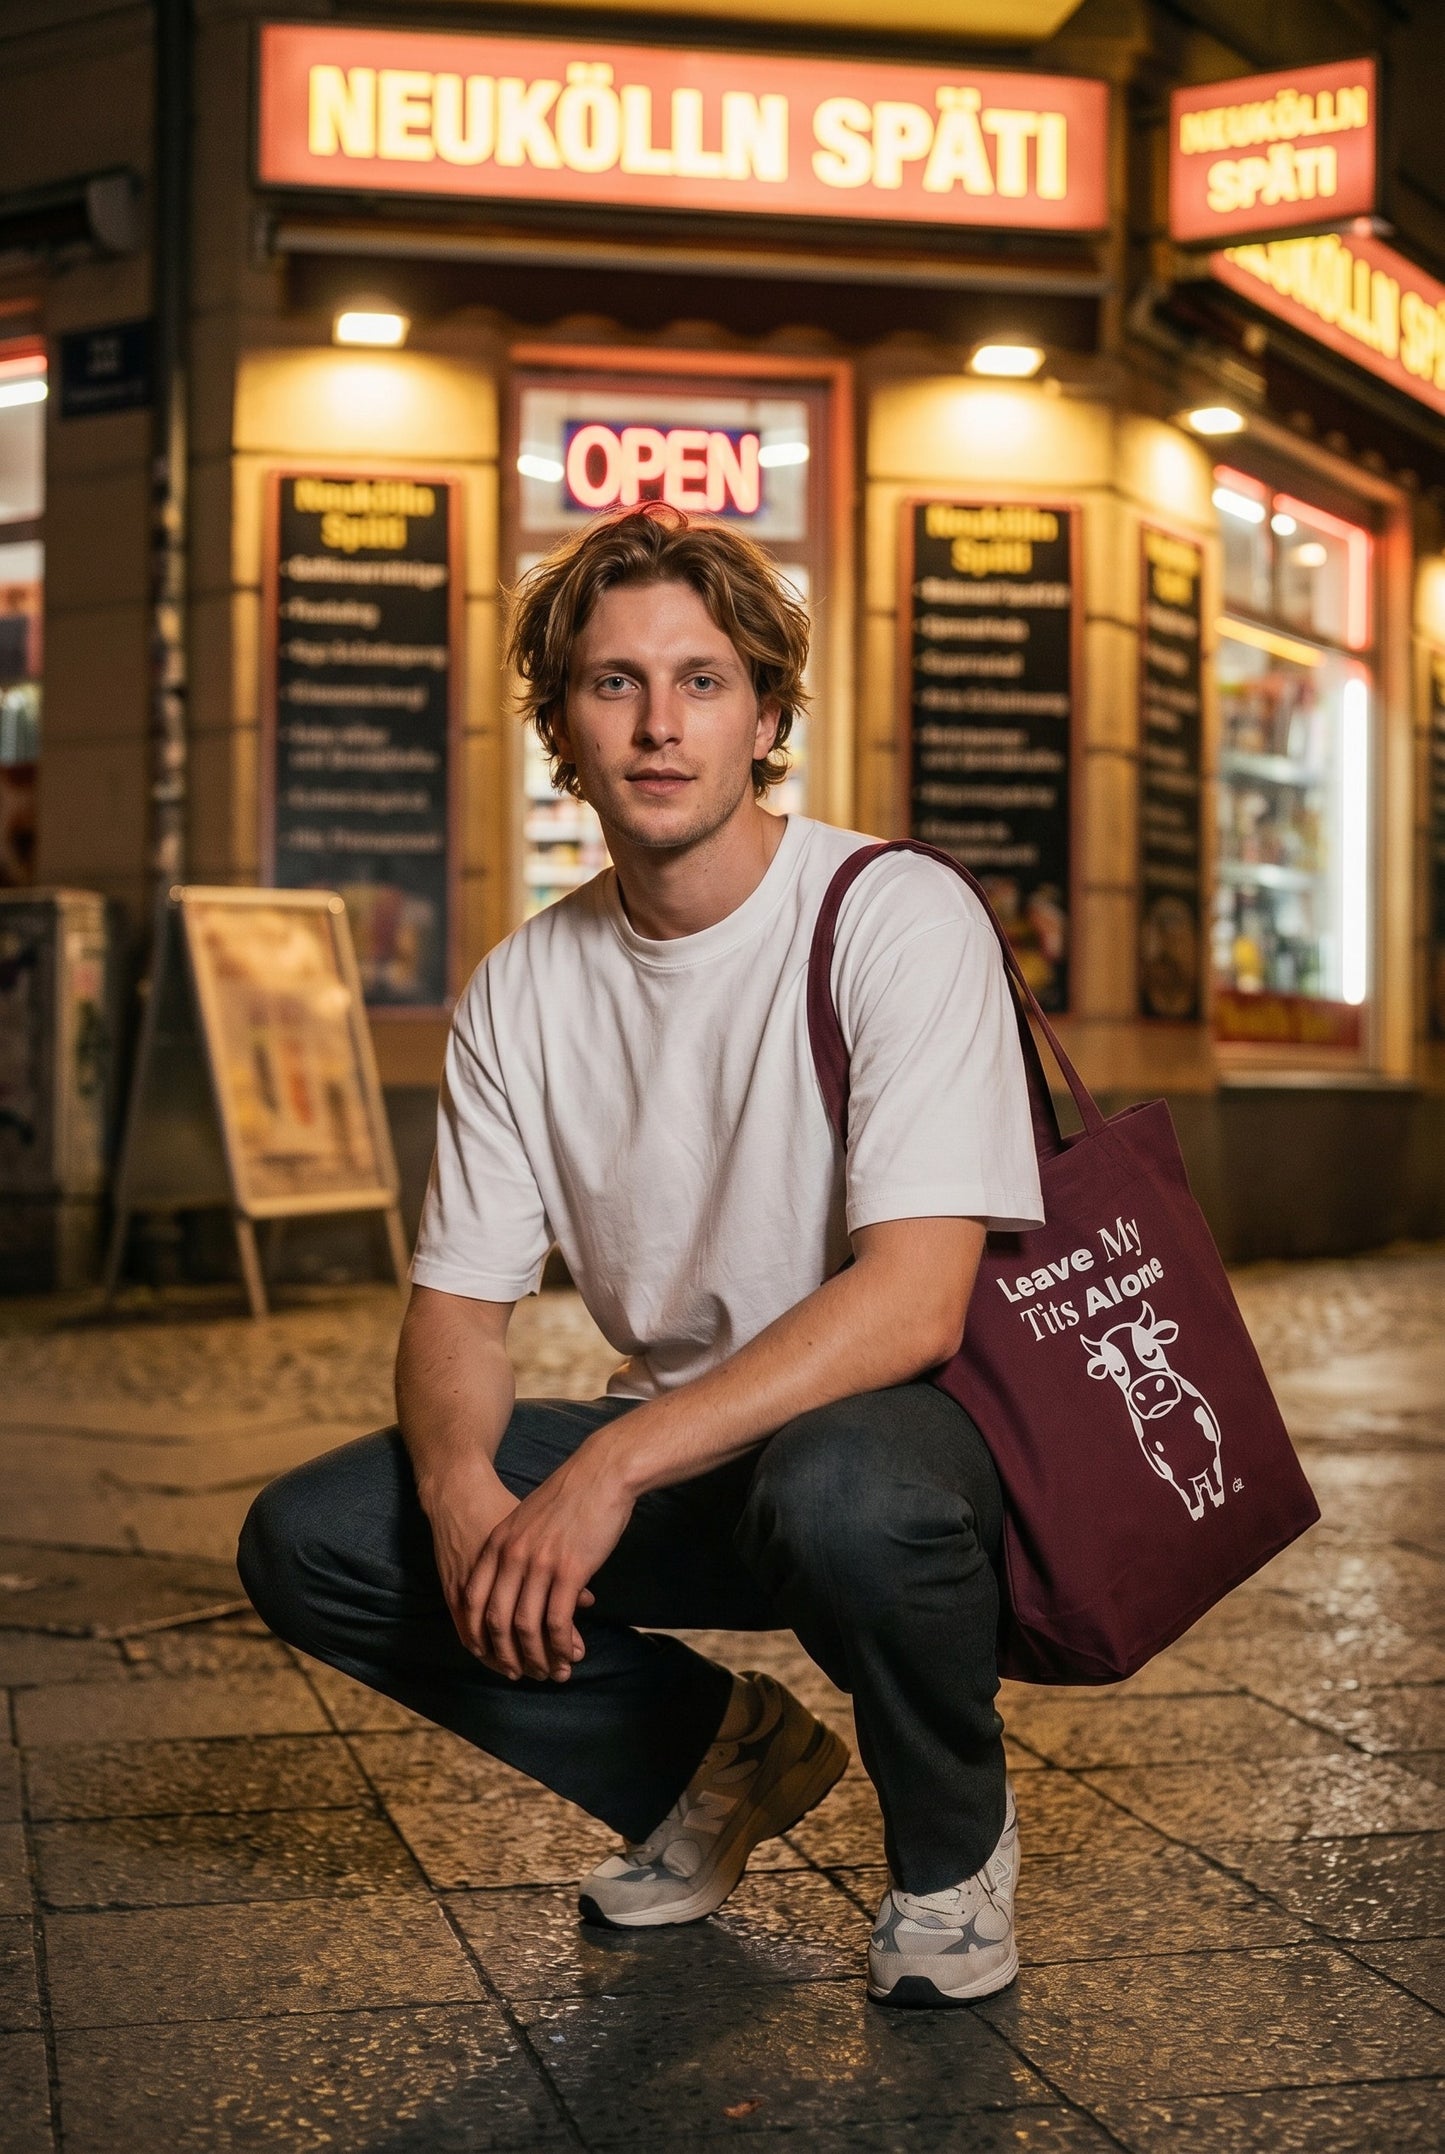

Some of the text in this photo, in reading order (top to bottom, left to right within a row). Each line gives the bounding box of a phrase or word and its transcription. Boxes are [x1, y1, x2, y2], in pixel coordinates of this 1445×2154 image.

[308, 61, 1067, 200] NEUKÖLLN SPÄTI
[1179, 85, 1368, 156] NEUKÖLLN
[1207, 142, 1337, 213] SPÄTI
[566, 424, 760, 514] OPEN
[996, 1216, 1142, 1303] Leave My
[1019, 1257, 1164, 1342] Tits Alone
